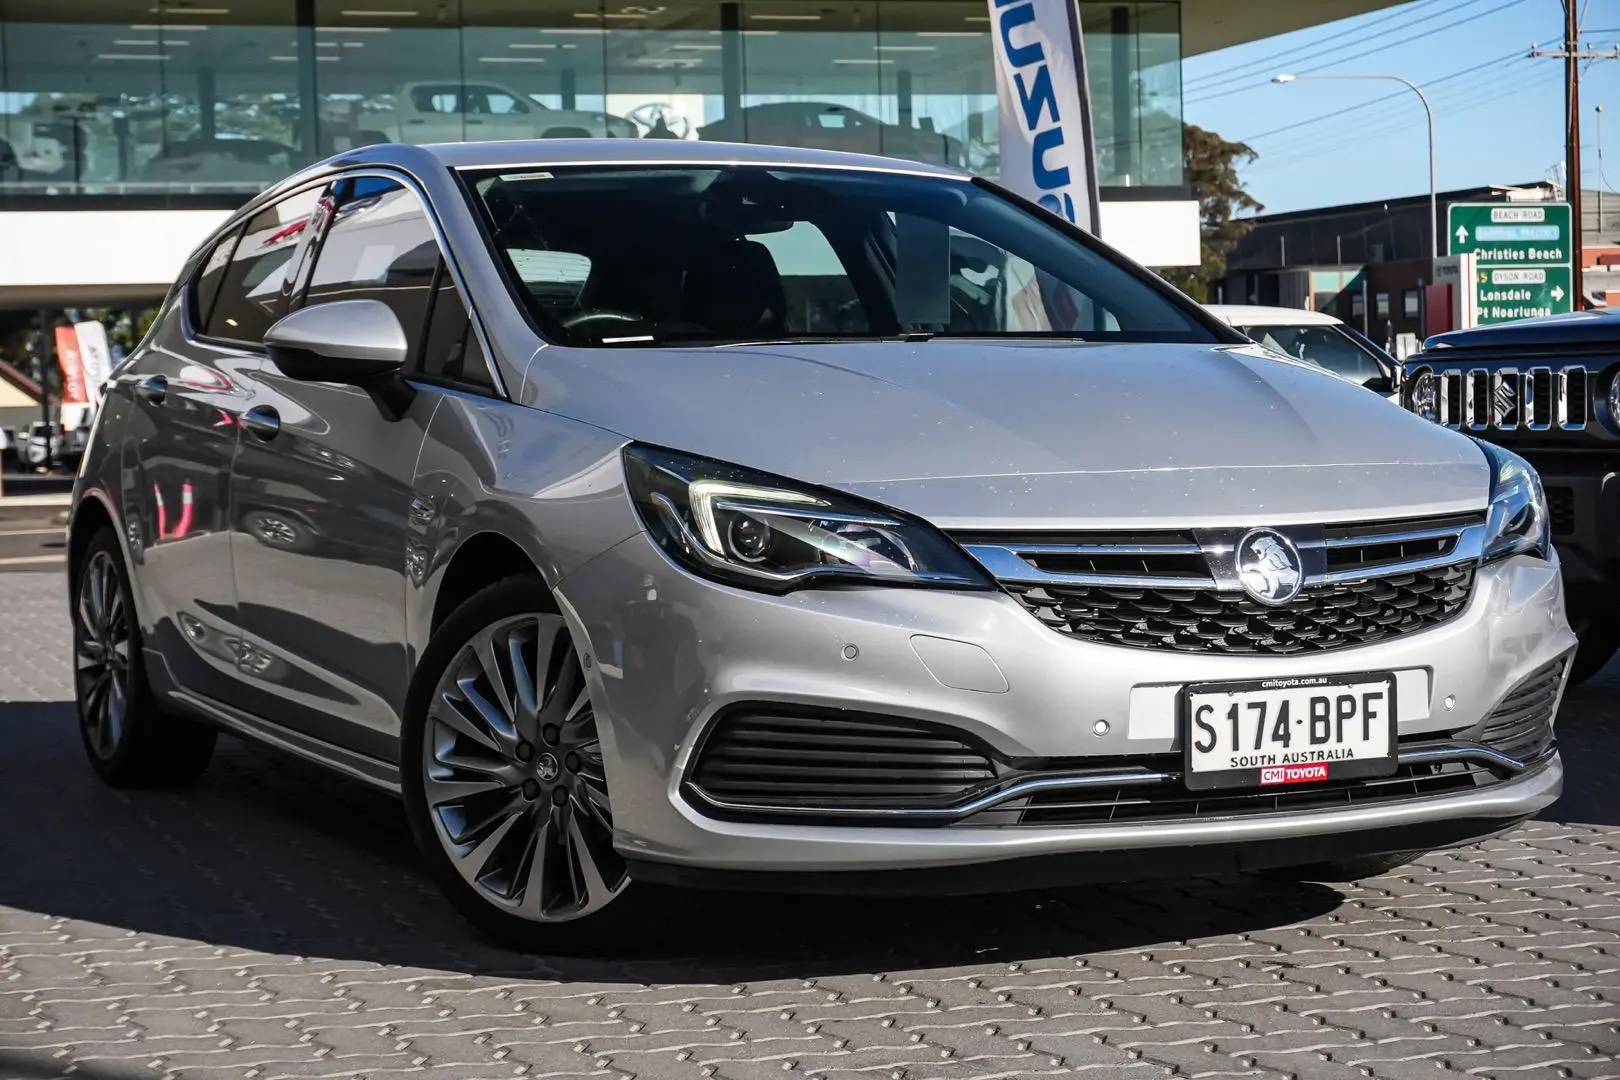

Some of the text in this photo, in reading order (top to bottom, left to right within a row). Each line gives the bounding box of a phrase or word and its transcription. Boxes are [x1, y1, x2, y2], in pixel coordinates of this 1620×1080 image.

[1493, 210, 1543, 220] BEACH ROAD
[1474, 247, 1562, 260] Christies Beach
[1494, 271, 1544, 282] DYSON ROAD
[1480, 289, 1531, 301] Lonsdale
[1262, 677, 1327, 688] cmitoyota.com.au
[1230, 748, 1354, 768] SOUTH AUSTRALIA
[1263, 766, 1327, 781] CMI TOYOTA
